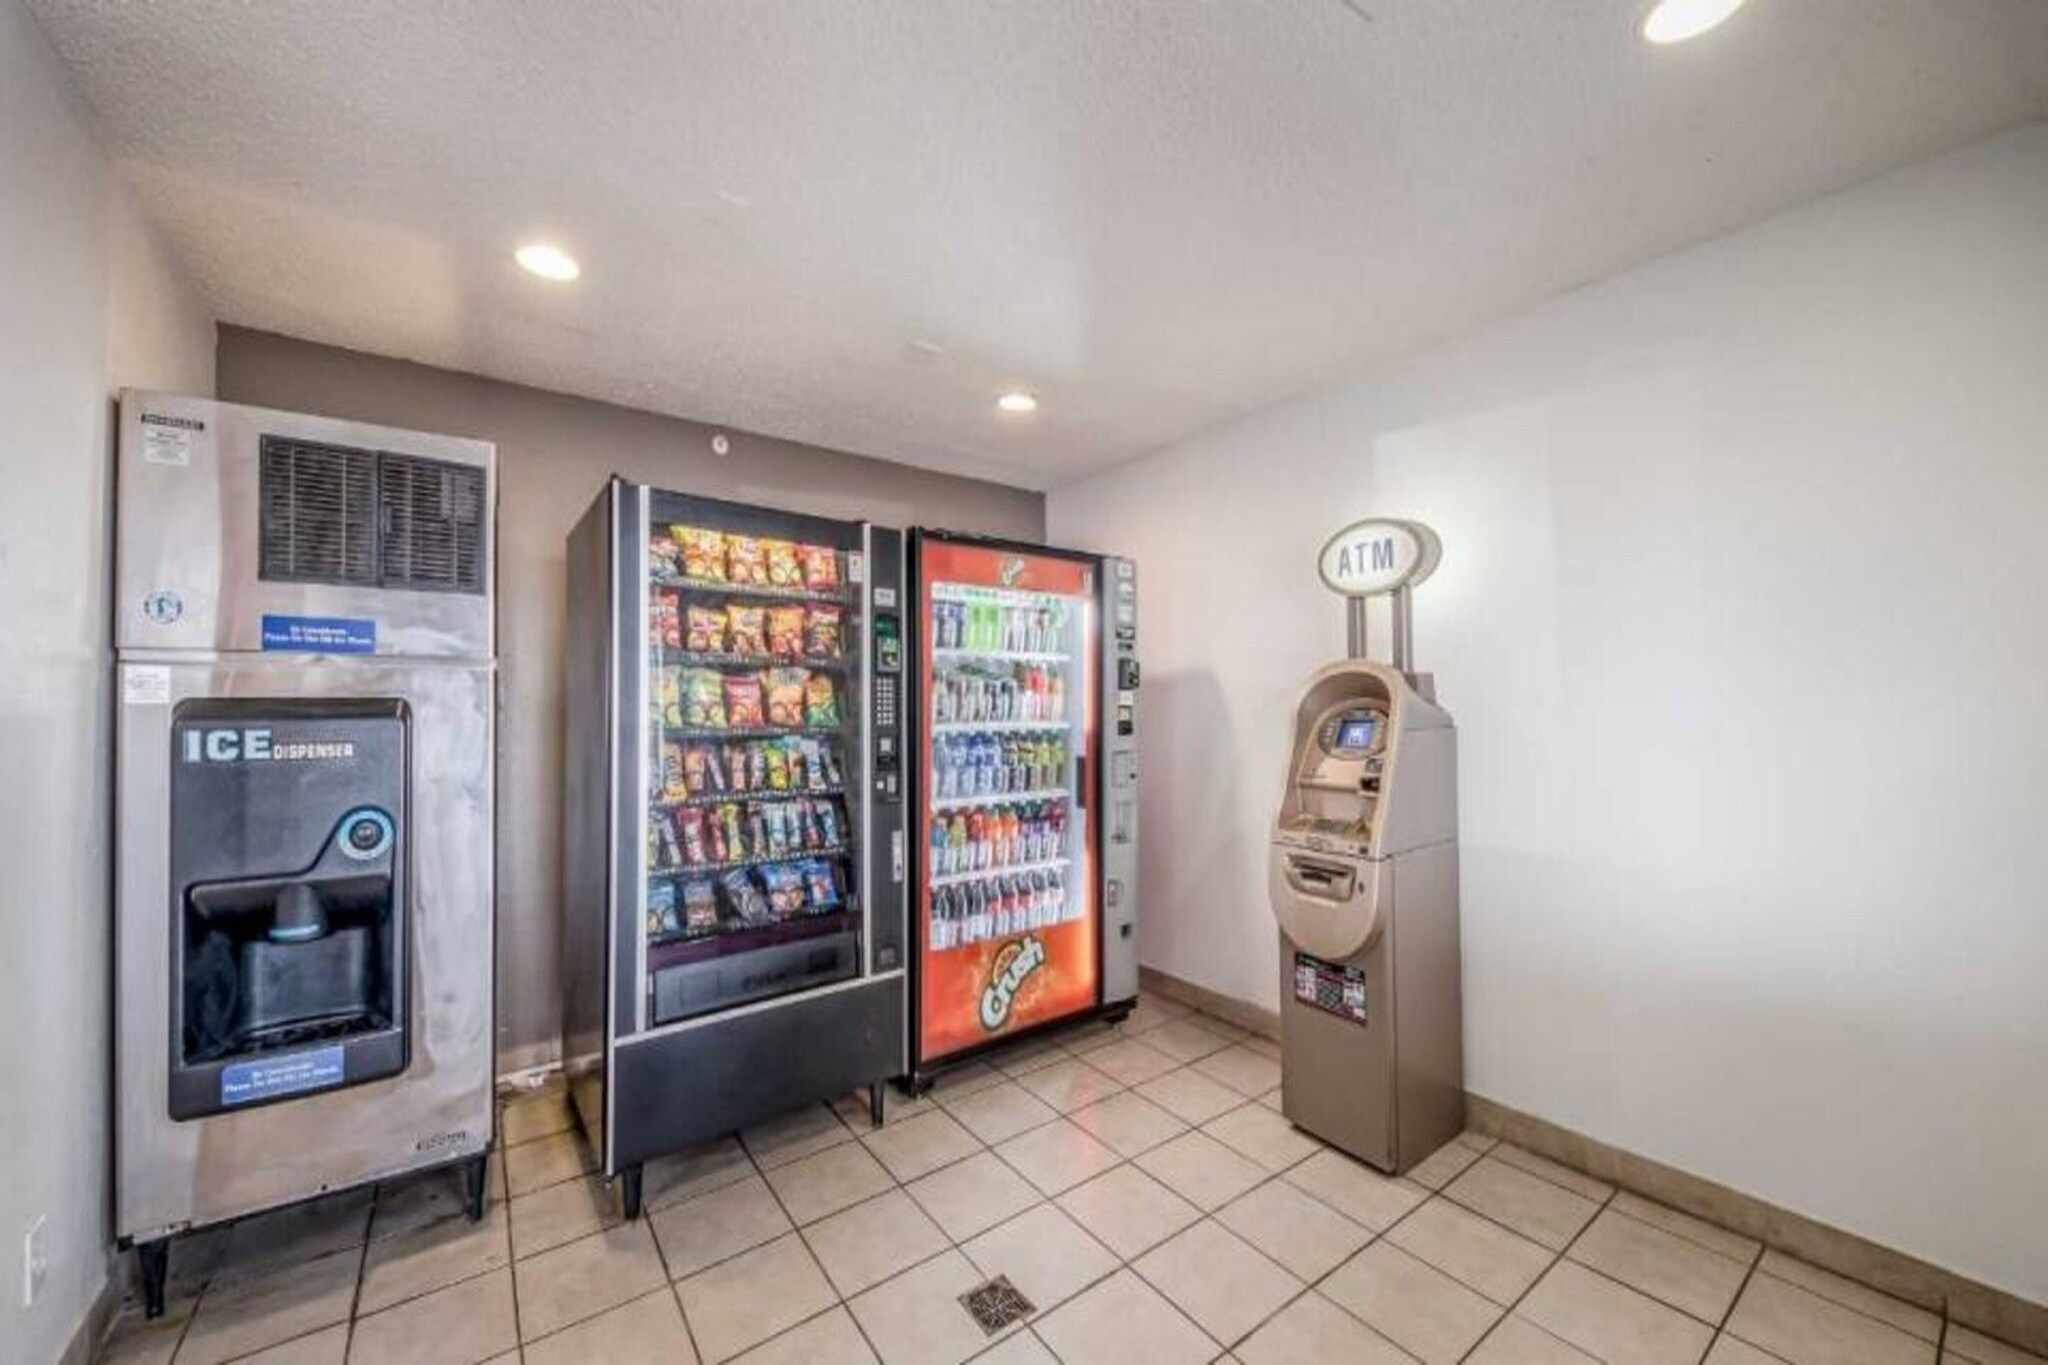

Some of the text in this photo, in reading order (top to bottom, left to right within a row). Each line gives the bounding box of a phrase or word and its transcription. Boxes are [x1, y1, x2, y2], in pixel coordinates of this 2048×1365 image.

[1337, 537, 1395, 579] ATM
[183, 729, 354, 763] ICE DISPENSER
[980, 936, 1046, 1029] Crush
